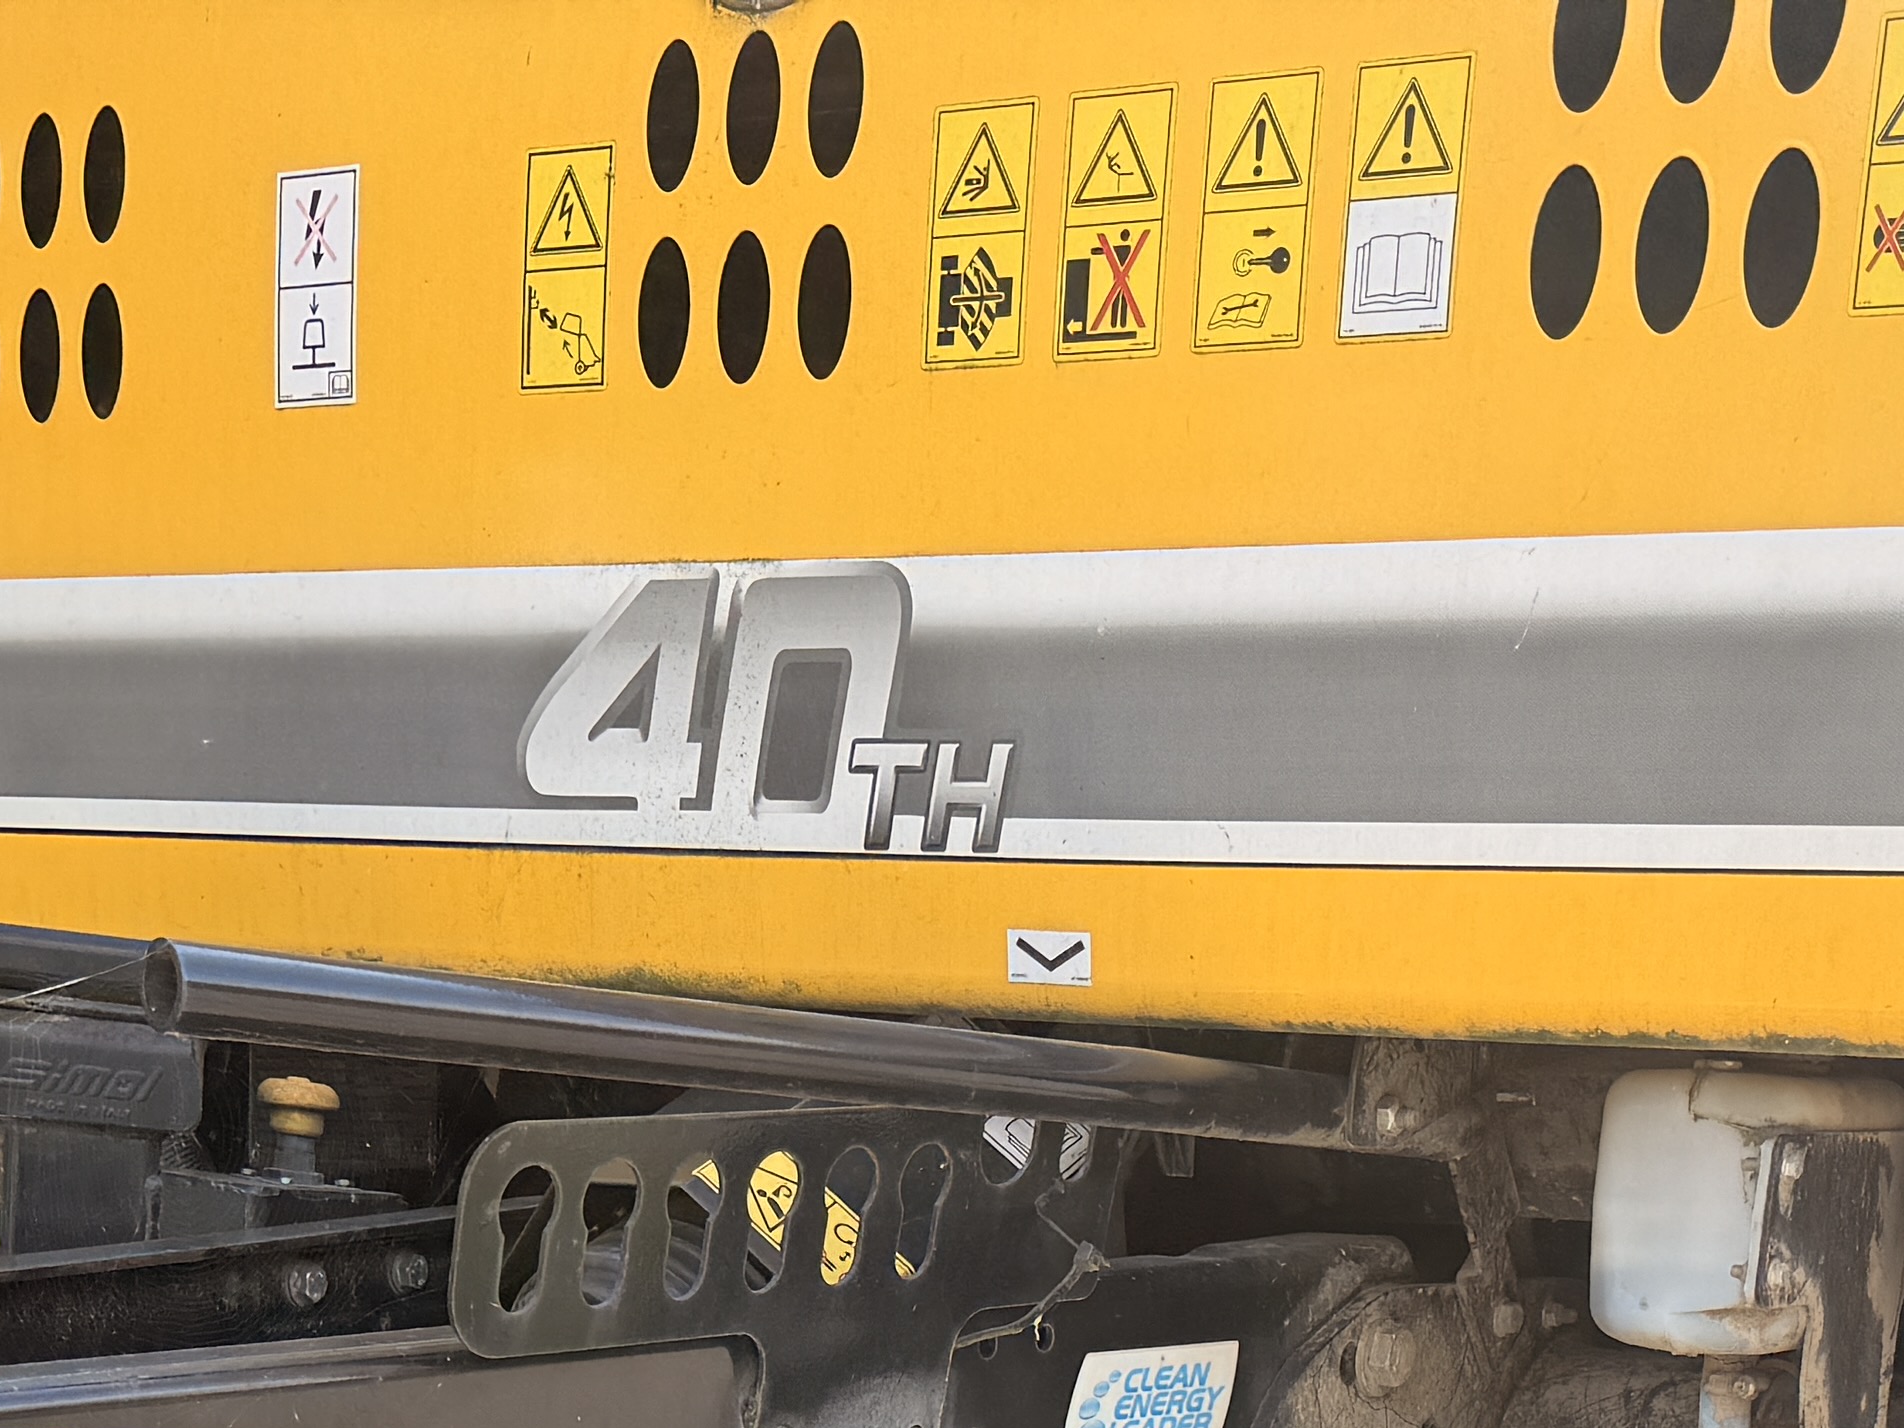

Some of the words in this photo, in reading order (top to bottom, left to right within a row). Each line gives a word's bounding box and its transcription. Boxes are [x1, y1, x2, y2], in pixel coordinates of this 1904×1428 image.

[517, 560, 914, 818] 40
[848, 738, 1015, 852] TH
[1124, 1361, 1212, 1394] CLEAN
[1114, 1385, 1225, 1421] ENERGY
